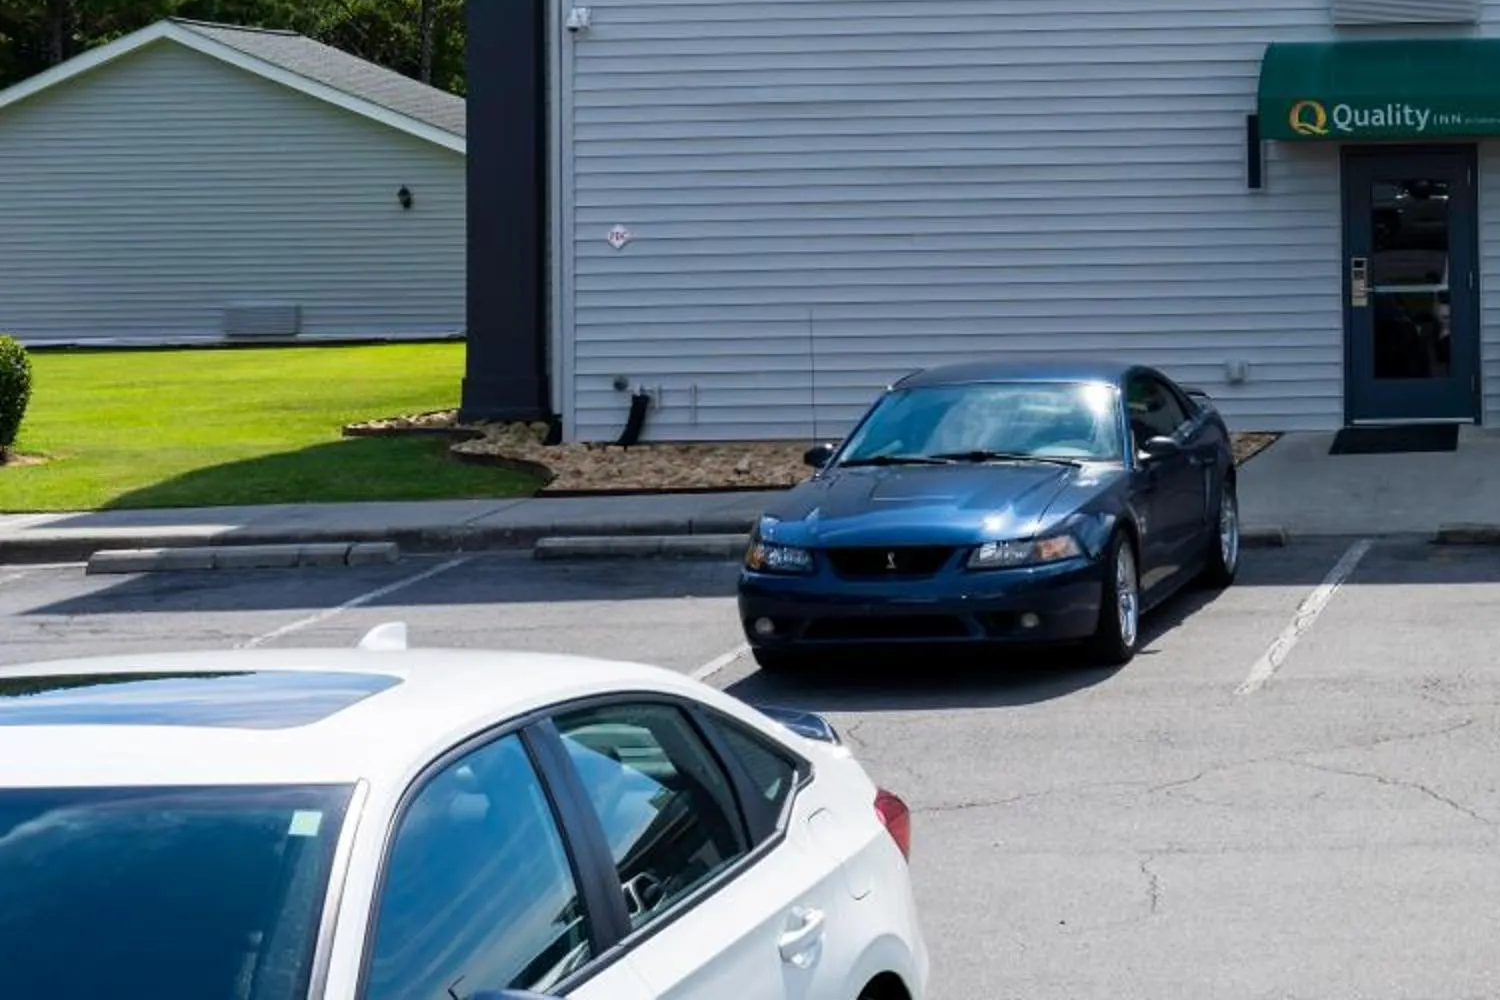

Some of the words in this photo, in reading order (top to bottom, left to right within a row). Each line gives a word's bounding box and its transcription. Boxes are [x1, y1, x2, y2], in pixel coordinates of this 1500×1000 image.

[1289, 100, 1328, 135] Q
[1333, 103, 1430, 132] Quality
[1433, 114, 1462, 125] INN
